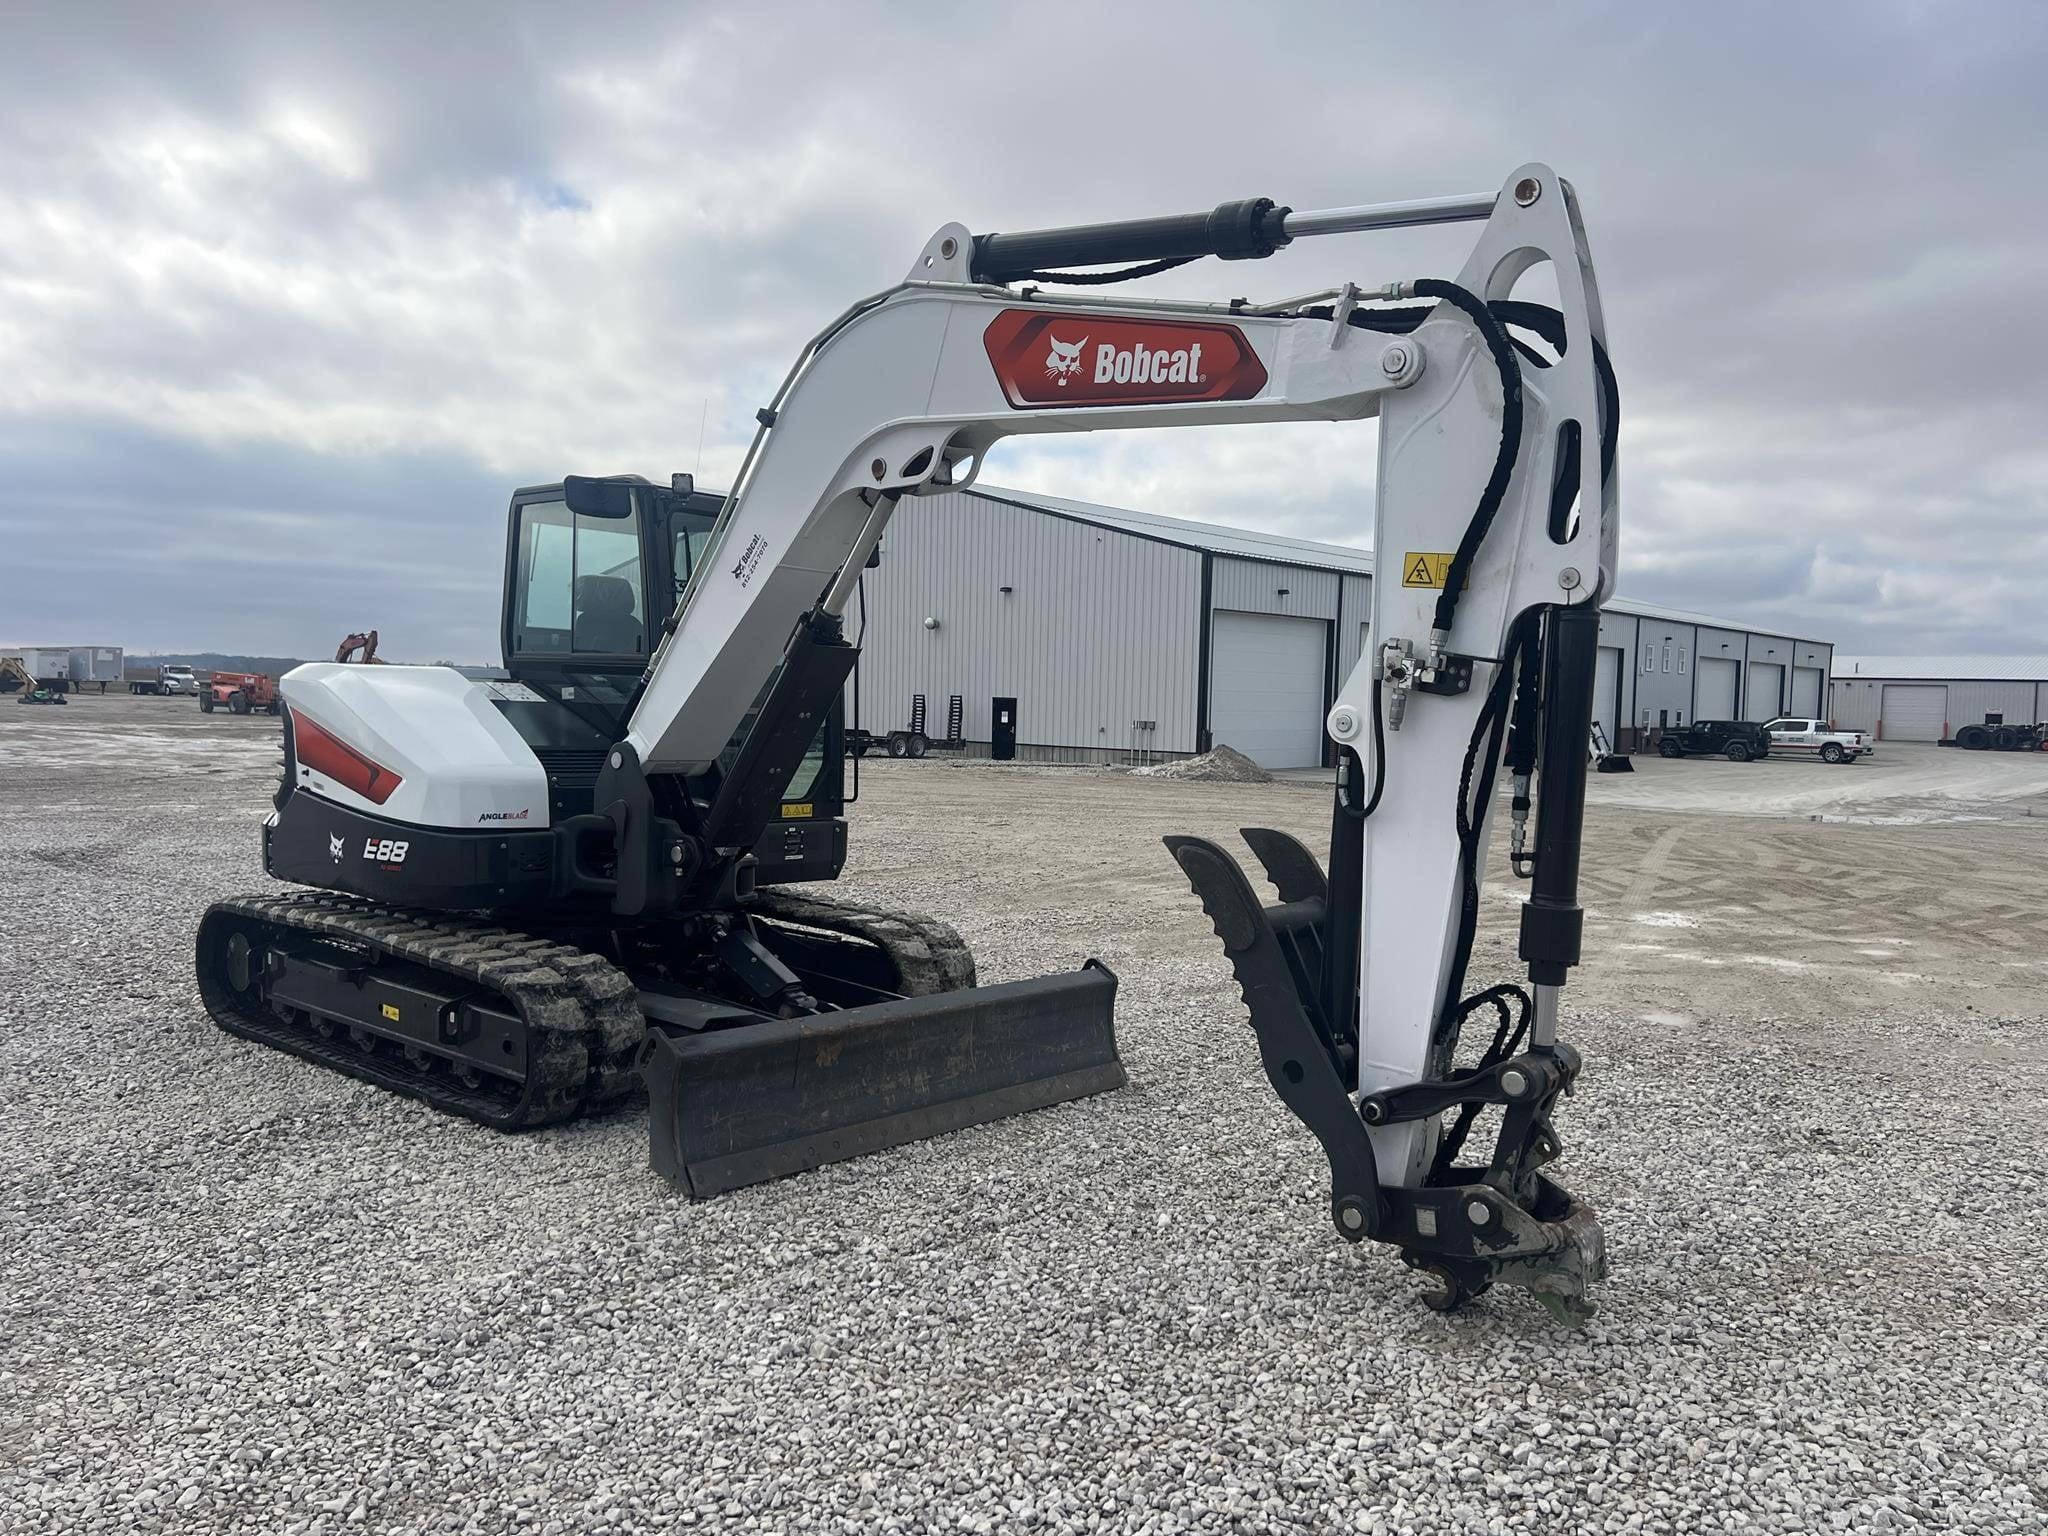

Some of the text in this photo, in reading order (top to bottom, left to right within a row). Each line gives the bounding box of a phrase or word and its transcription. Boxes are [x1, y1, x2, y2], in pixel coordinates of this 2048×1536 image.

[1094, 343, 1201, 384] Bobcat
[741, 534, 761, 565] Bobcat
[742, 541, 768, 588] 812-254-7070
[363, 838, 409, 862] E88
